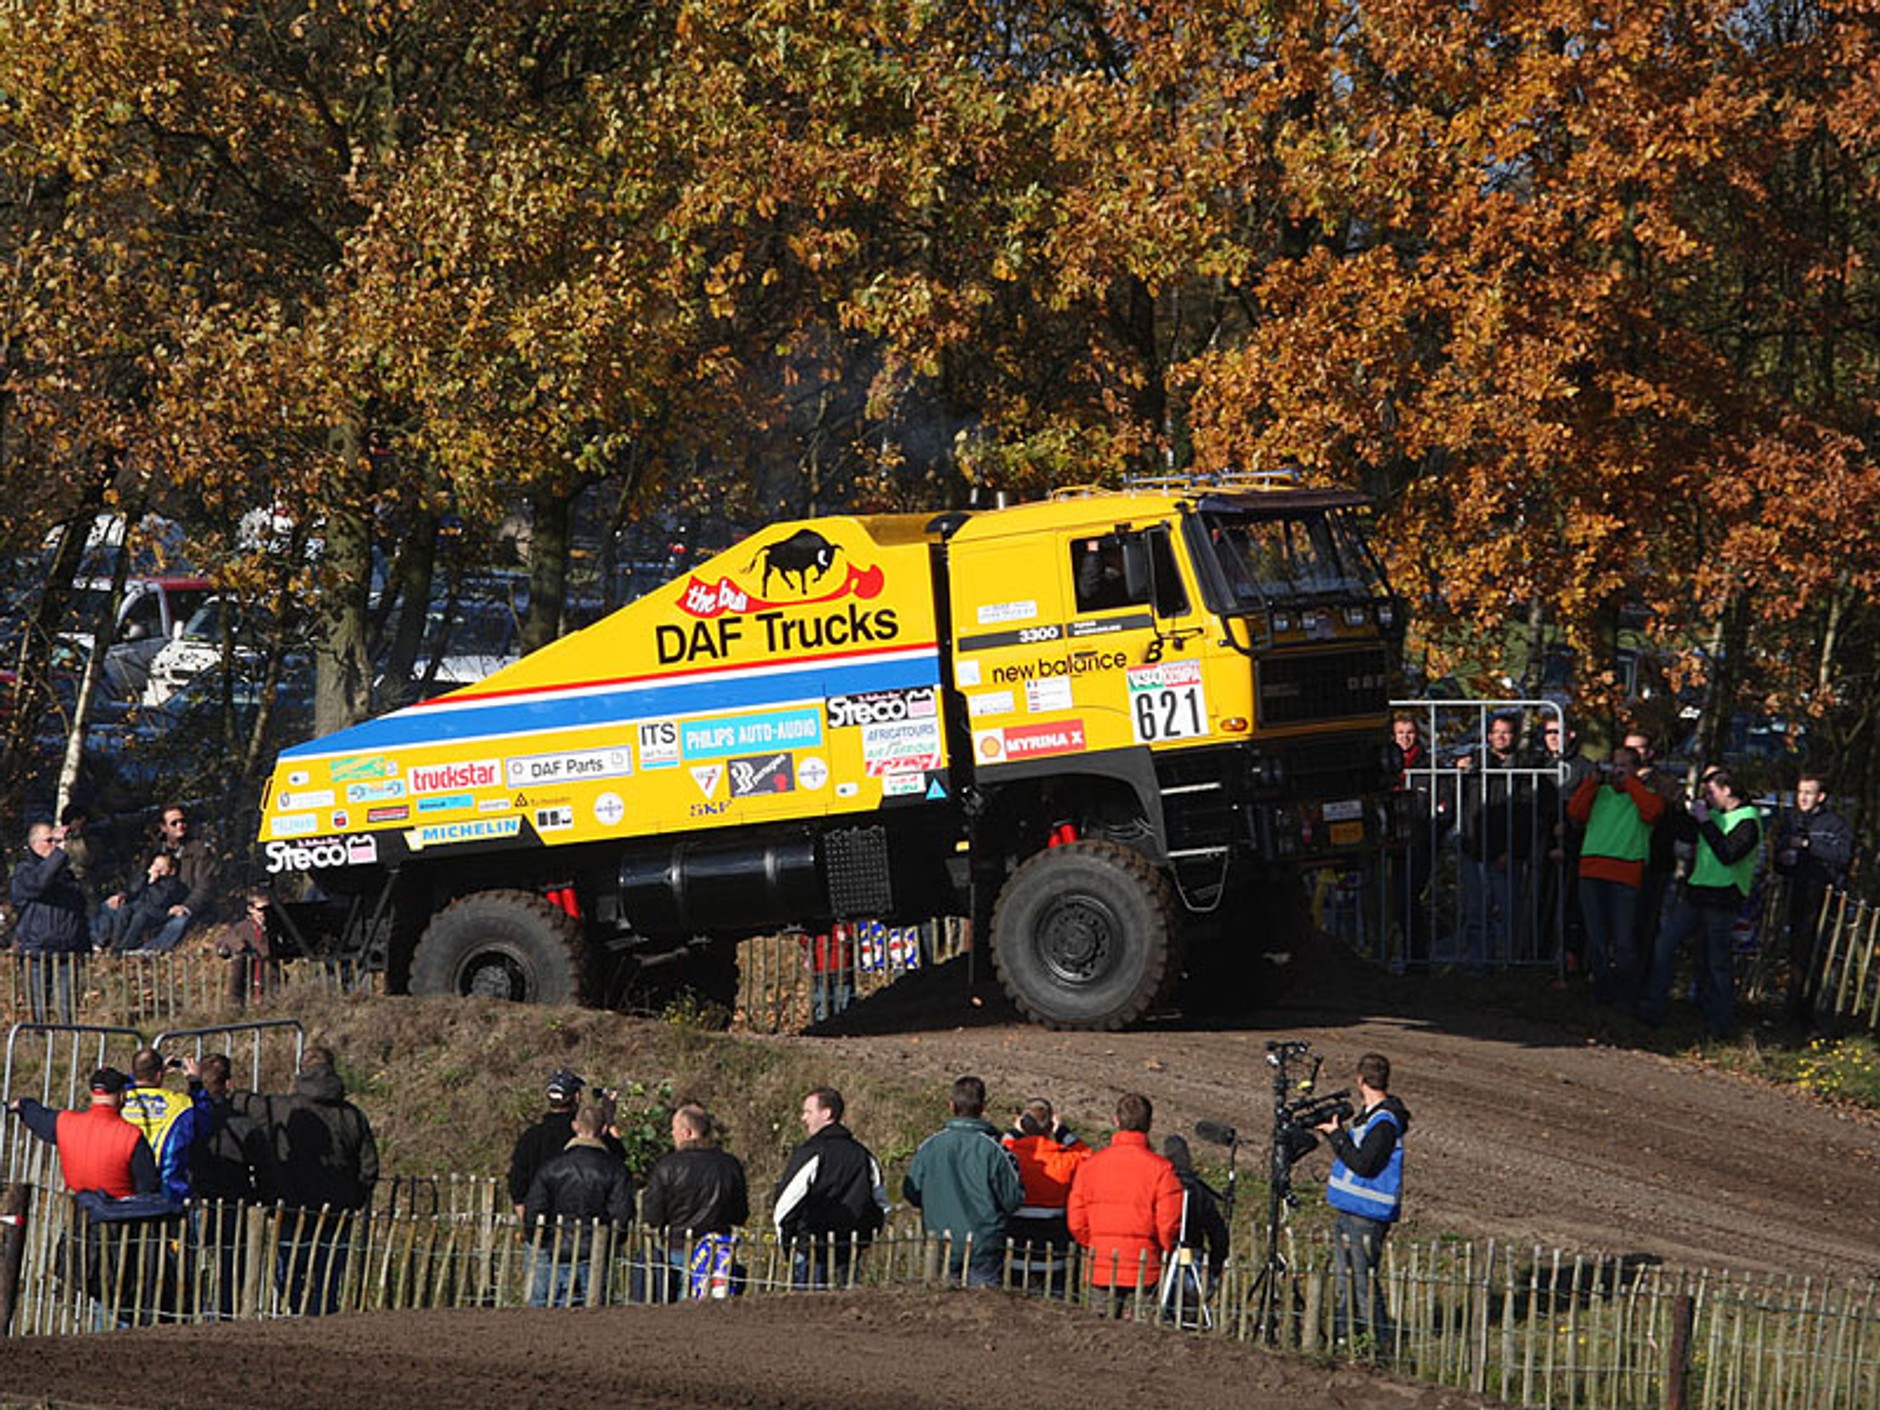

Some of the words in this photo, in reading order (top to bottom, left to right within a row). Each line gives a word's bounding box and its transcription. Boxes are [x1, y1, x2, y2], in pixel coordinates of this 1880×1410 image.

[686, 584, 716, 612] the
[655, 616, 743, 665] DAF
[756, 604, 899, 652] Trucks
[1018, 627, 1059, 643] 3300
[993, 663, 1035, 683] new
[1038, 652, 1127, 677] balance
[828, 696, 906, 728] Steco
[1135, 688, 1201, 741] 621
[641, 723, 676, 746] ITS
[685, 727, 735, 750] PHILIPS
[738, 717, 818, 743] AUTO-AUDIO
[1006, 732, 1068, 752] MYRINA
[1071, 730, 1084, 744] X
[413, 763, 495, 792] truckstar
[531, 760, 561, 778] DAF
[566, 757, 604, 774] Parts
[422, 819, 518, 841] MICHELIN
[265, 841, 346, 873] Steco
